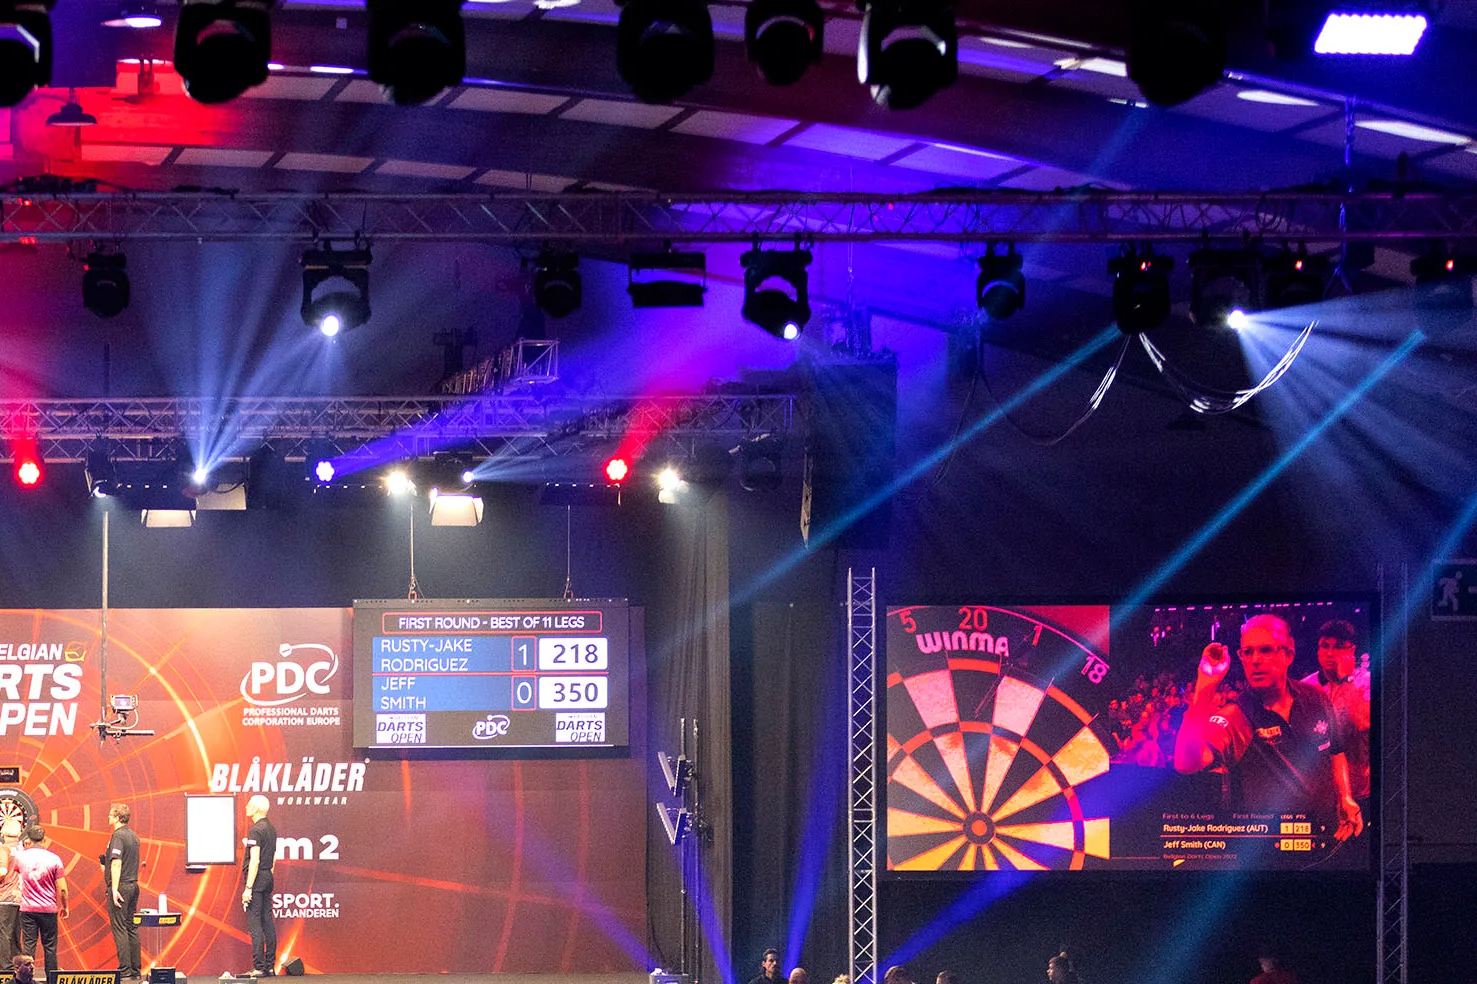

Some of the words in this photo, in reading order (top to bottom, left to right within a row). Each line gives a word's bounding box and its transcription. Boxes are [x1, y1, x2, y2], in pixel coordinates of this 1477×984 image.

[398, 617, 432, 630] FIRST
[435, 616, 481, 630] ROUND
[490, 616, 520, 629] BEST
[523, 616, 540, 629] OF
[543, 616, 552, 628] 11
[554, 616, 585, 628] LEGS
[899, 611, 917, 633] 5
[958, 607, 988, 631] 20
[1032, 624, 1043, 646] 1
[381, 638, 472, 652] RUSTY-JAKE
[518, 644, 527, 665] 1
[553, 644, 598, 664] 218
[381, 657, 468, 672] RODRIGUEZ
[1080, 655, 1109, 685] 18
[251, 661, 331, 694] PDC
[381, 676, 416, 691] JEFF
[516, 681, 532, 704] 0
[553, 682, 599, 702] 350
[381, 696, 426, 710] SMITH
[243, 707, 308, 716] PROFESSIONAL
[310, 707, 339, 715] DARTS
[242, 717, 303, 726] CORPORATION
[306, 717, 341, 725] EUROPE
[377, 721, 423, 732] DARTS
[476, 721, 508, 735] PDC
[557, 720, 603, 731] DARTS
[390, 732, 423, 744] OPEN
[570, 732, 602, 742] OPEN
[210, 756, 366, 792] BLÅKLÄDER
[277, 796, 348, 805] WORKWEAR
[1163, 824, 1206, 834] Rusty-Jake
[1207, 824, 1245, 834] Rodriguez
[1246, 824, 1268, 833] (AUT)
[319, 834, 340, 860] 2
[1163, 840, 1180, 848] Jeff
[1181, 840, 1203, 848] Smith
[1203, 840, 1226, 850] (CAN)
[272, 909, 339, 919] VLAANDEREN
